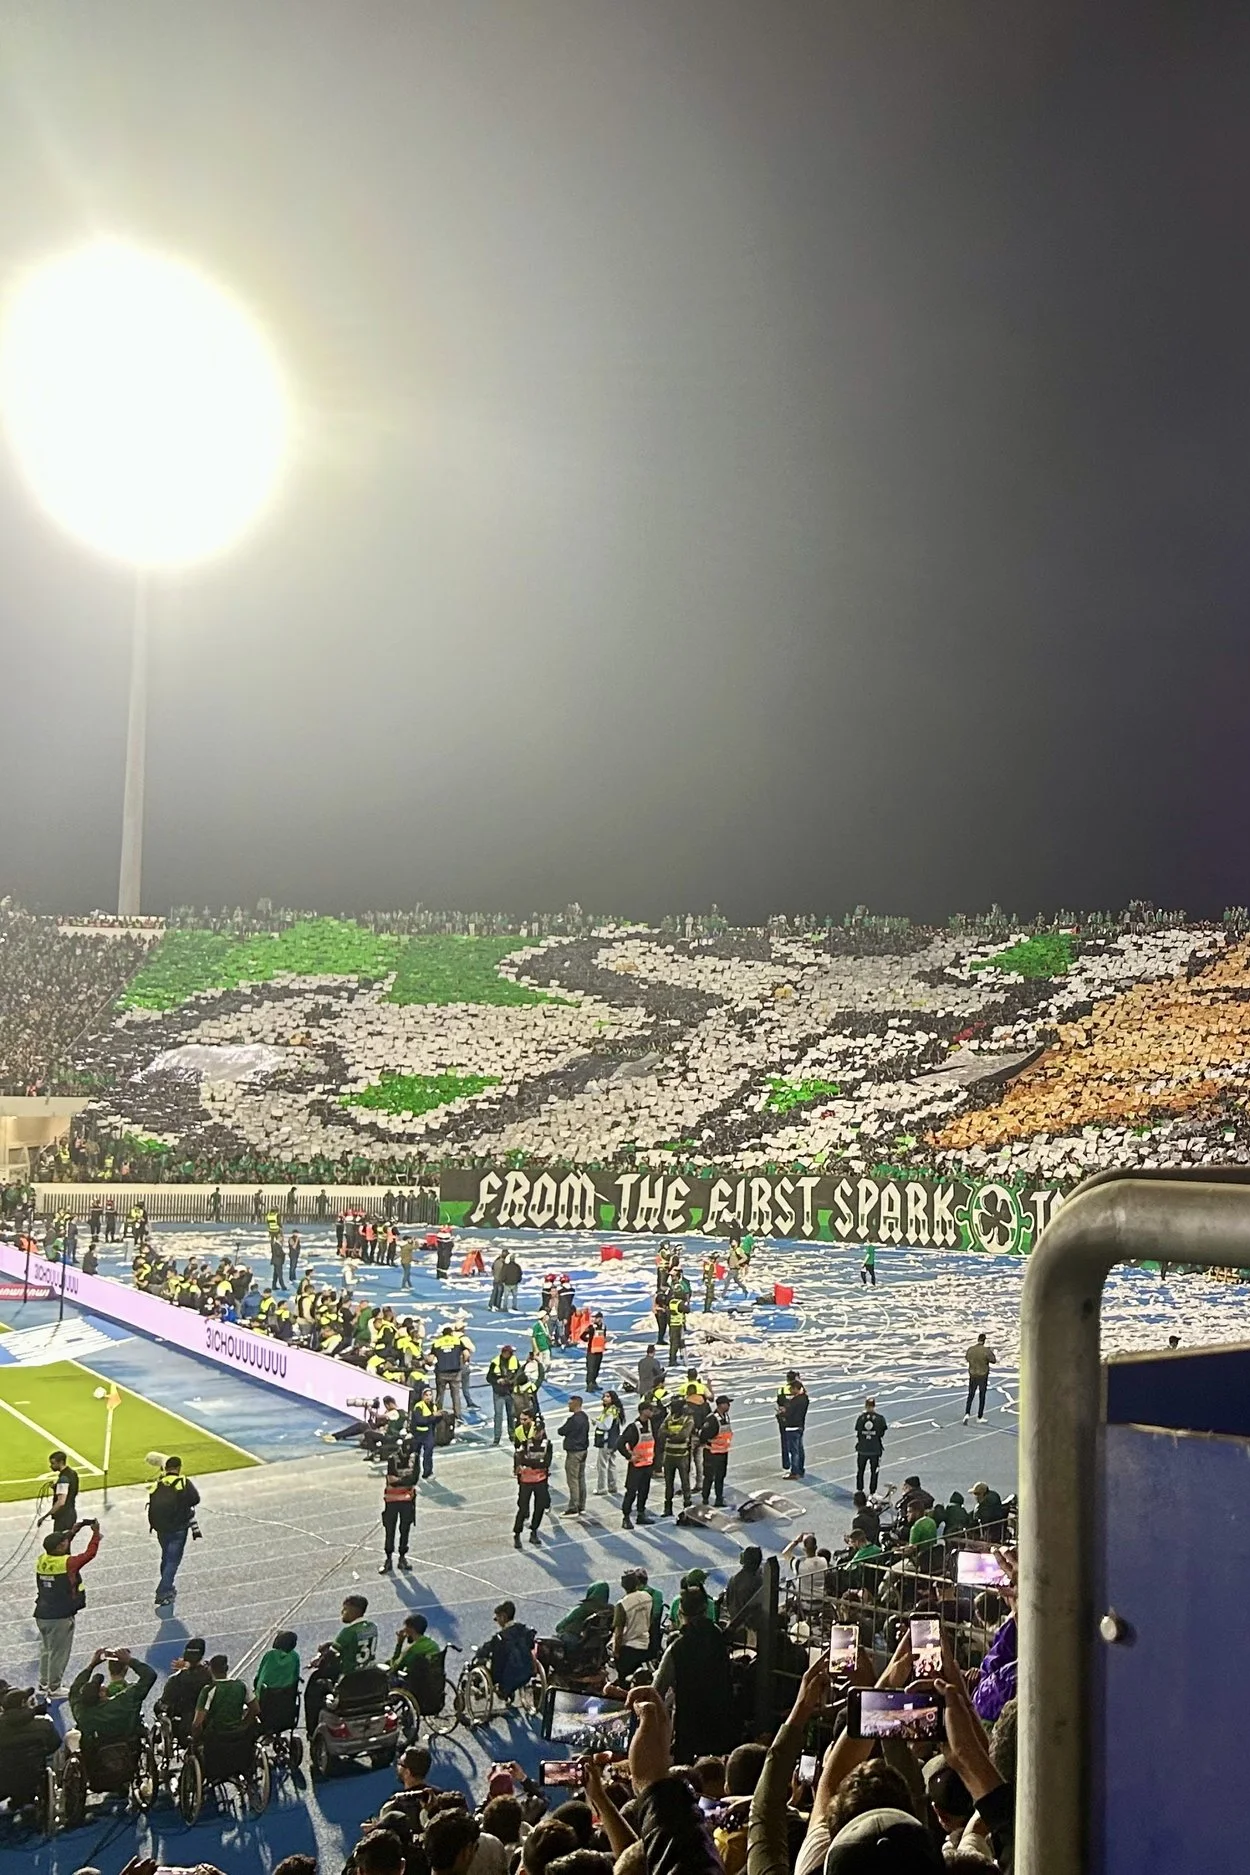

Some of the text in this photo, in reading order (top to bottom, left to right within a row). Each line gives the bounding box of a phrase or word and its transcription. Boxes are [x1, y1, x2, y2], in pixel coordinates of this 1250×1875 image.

[470, 1171, 597, 1229] FROM
[614, 1174, 691, 1232] THE
[702, 1176, 821, 1237] FIRST
[834, 1177, 957, 1247] SPARK
[206, 1327, 288, 1379] 3ICHOUUUUUUU
